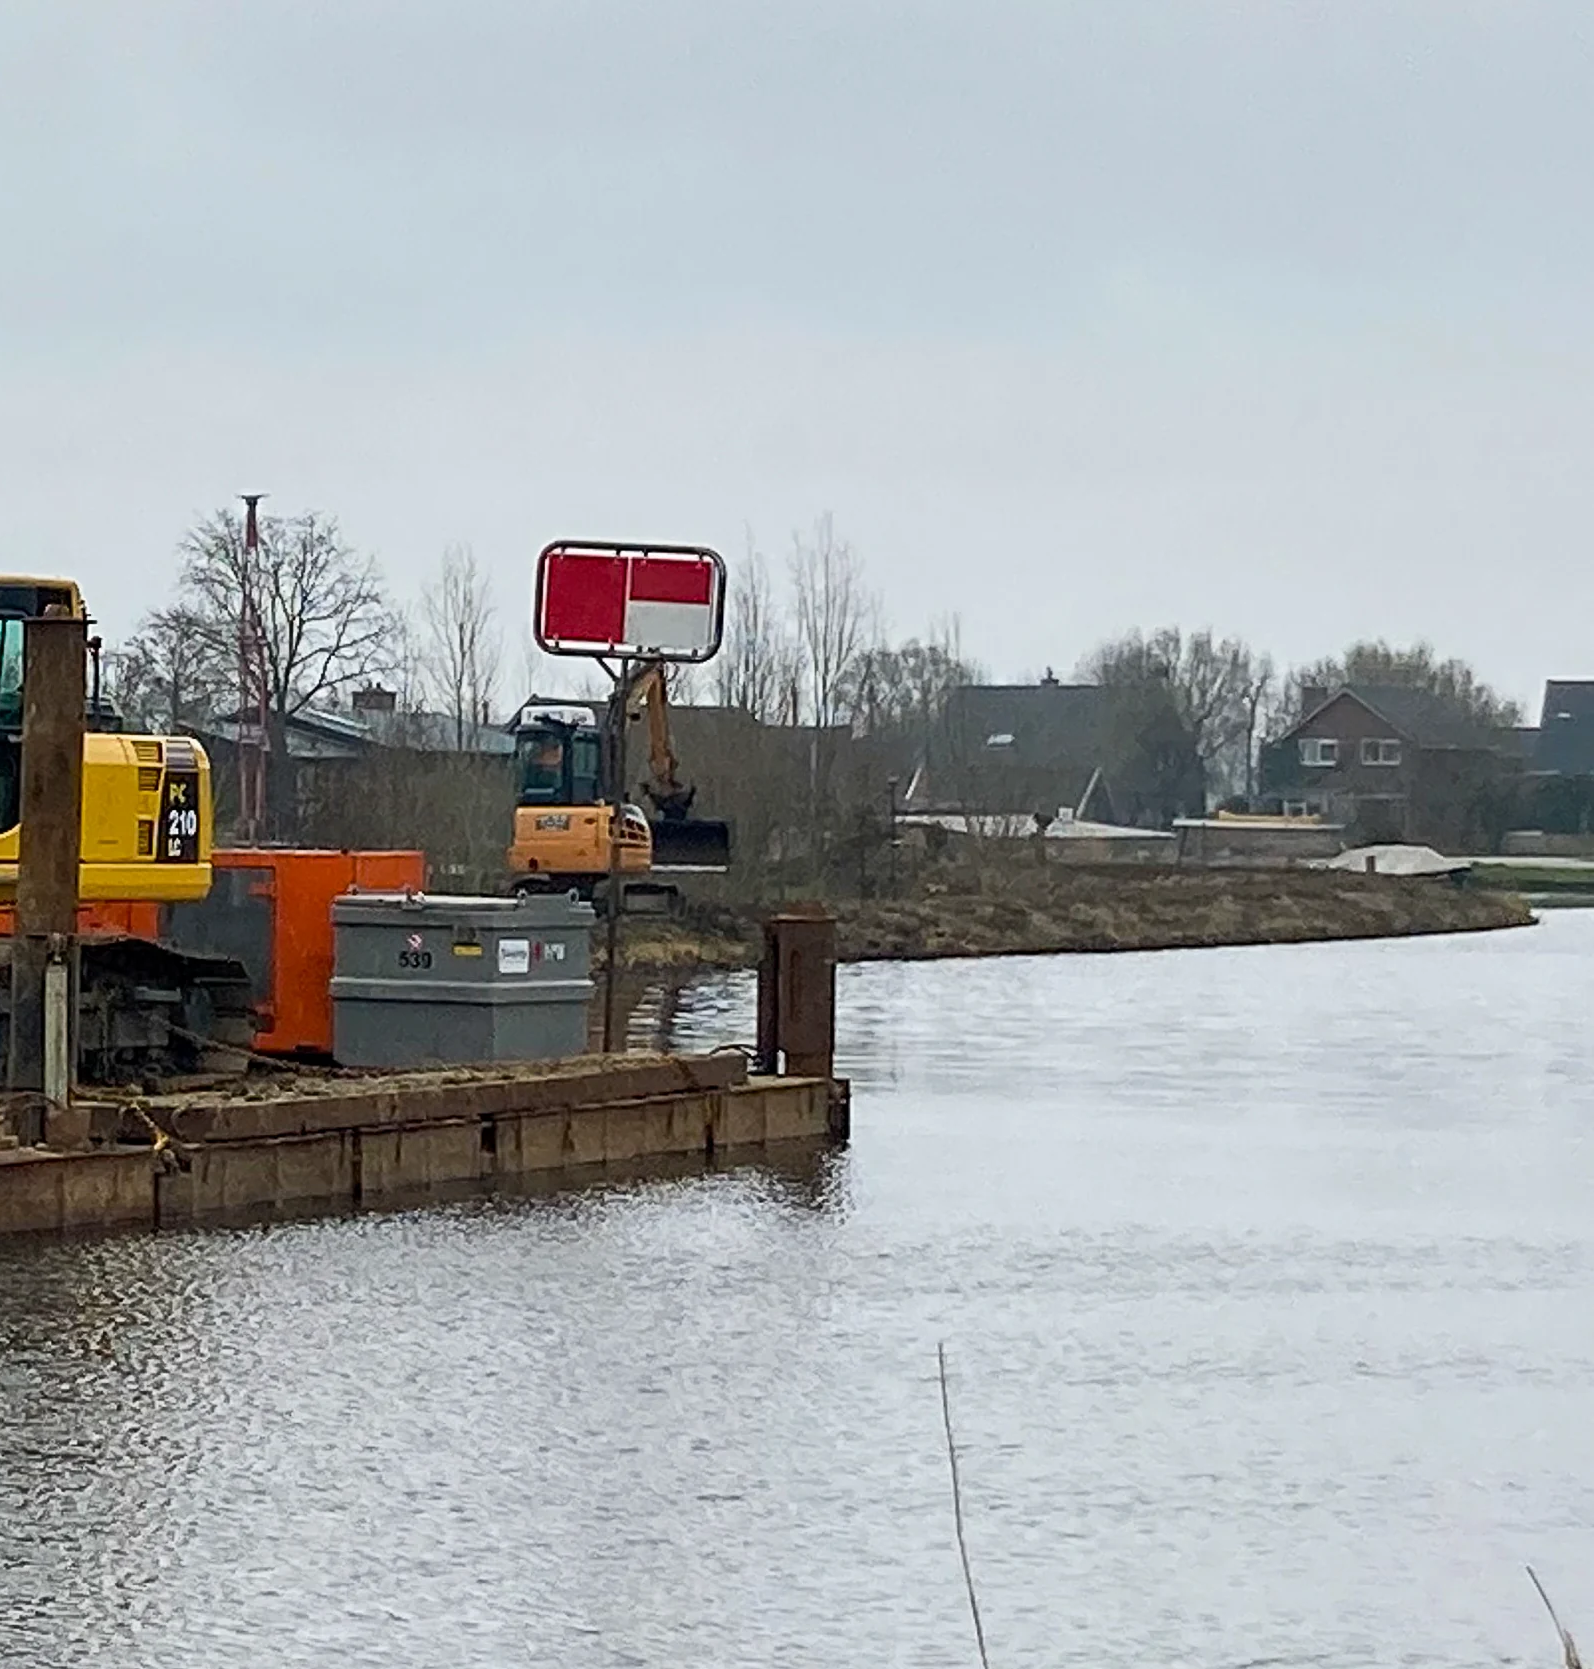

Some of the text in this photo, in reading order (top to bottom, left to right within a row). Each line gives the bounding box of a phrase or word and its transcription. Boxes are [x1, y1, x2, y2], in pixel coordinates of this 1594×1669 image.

[169, 782, 187, 804] PC
[168, 809, 197, 836] 210
[398, 950, 432, 969] 539
